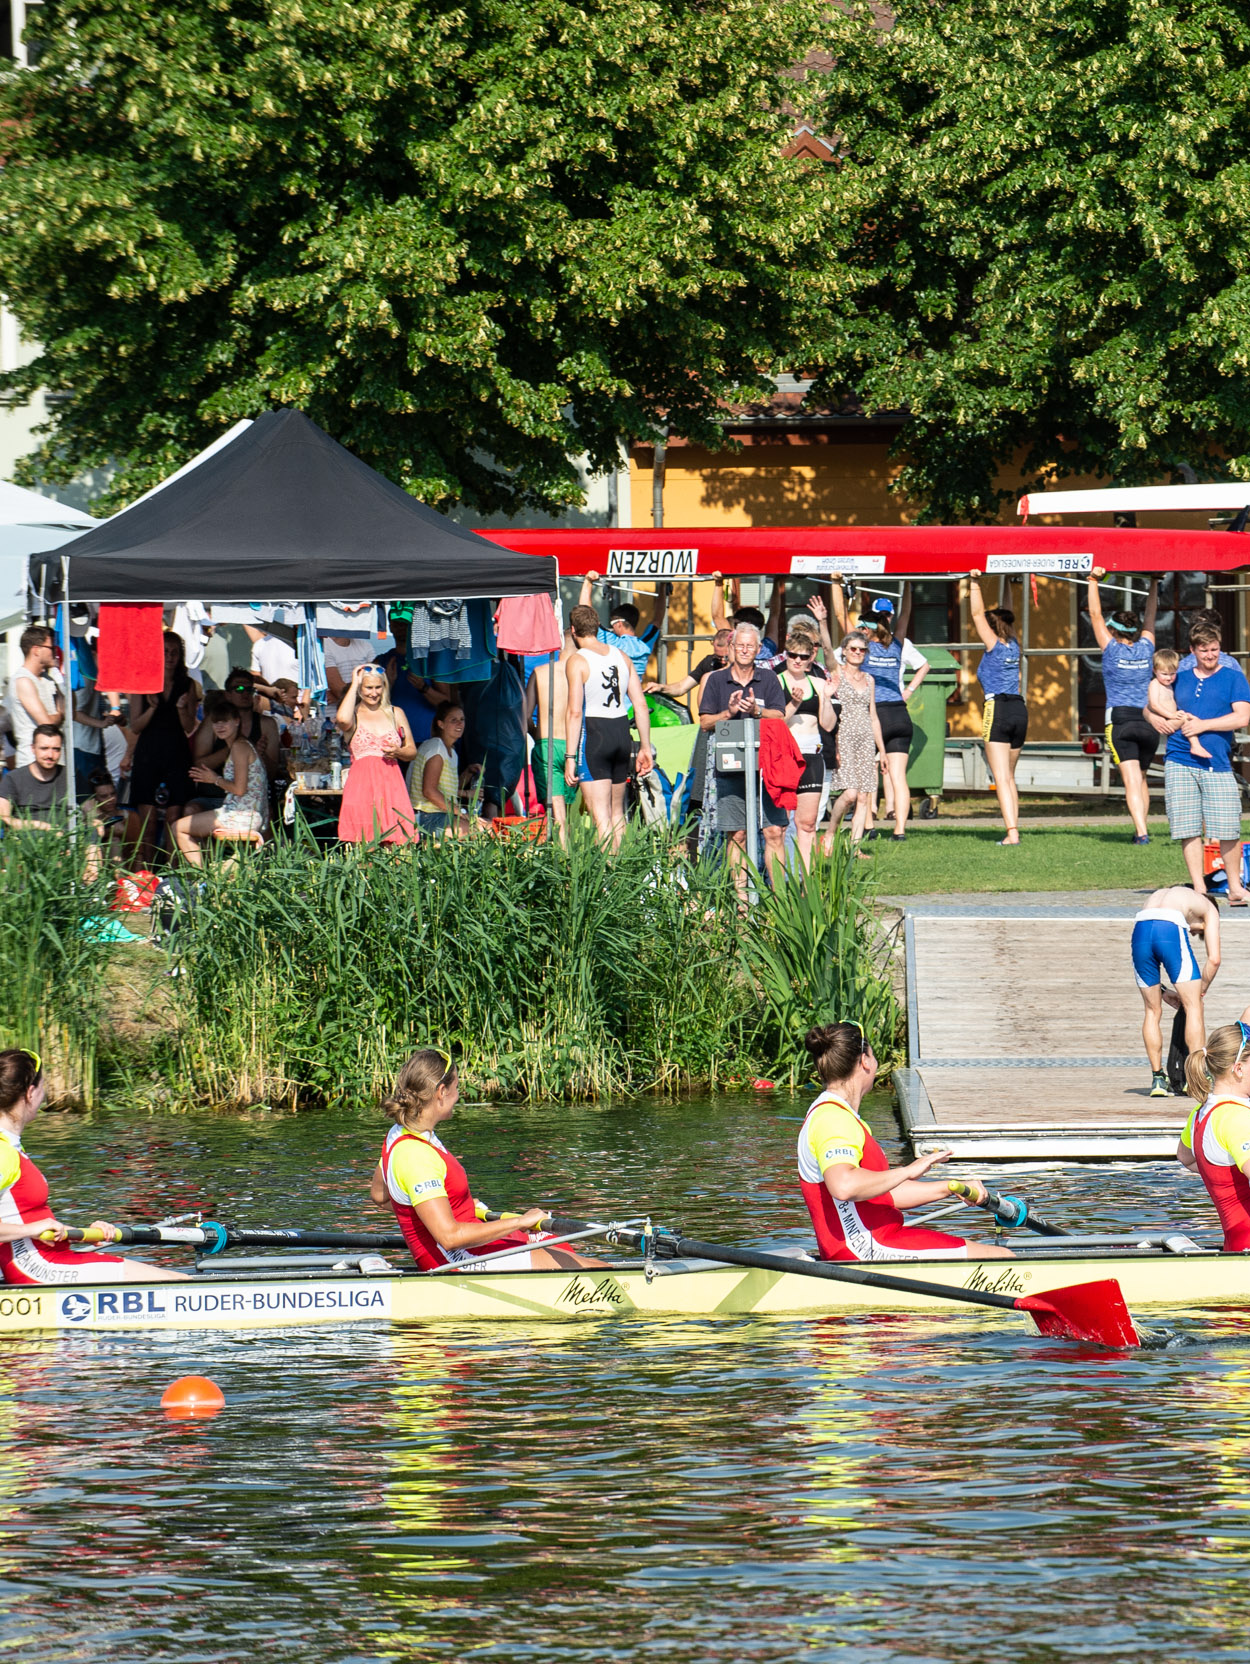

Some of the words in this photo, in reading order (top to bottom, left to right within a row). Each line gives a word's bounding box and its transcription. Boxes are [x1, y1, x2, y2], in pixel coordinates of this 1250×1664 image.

[609, 550, 693, 574] WURZEN
[989, 558, 1056, 568] RUDER-BUNDESLIGA
[1057, 559, 1079, 570] RBL
[834, 1147, 855, 1158] RBL
[424, 1179, 442, 1190] RBL
[961, 1263, 1027, 1293] Melitta
[553, 1274, 625, 1306] Melitta
[97, 1291, 166, 1314] RBL
[174, 1290, 385, 1312] RUDER-BUNDESLIGA
